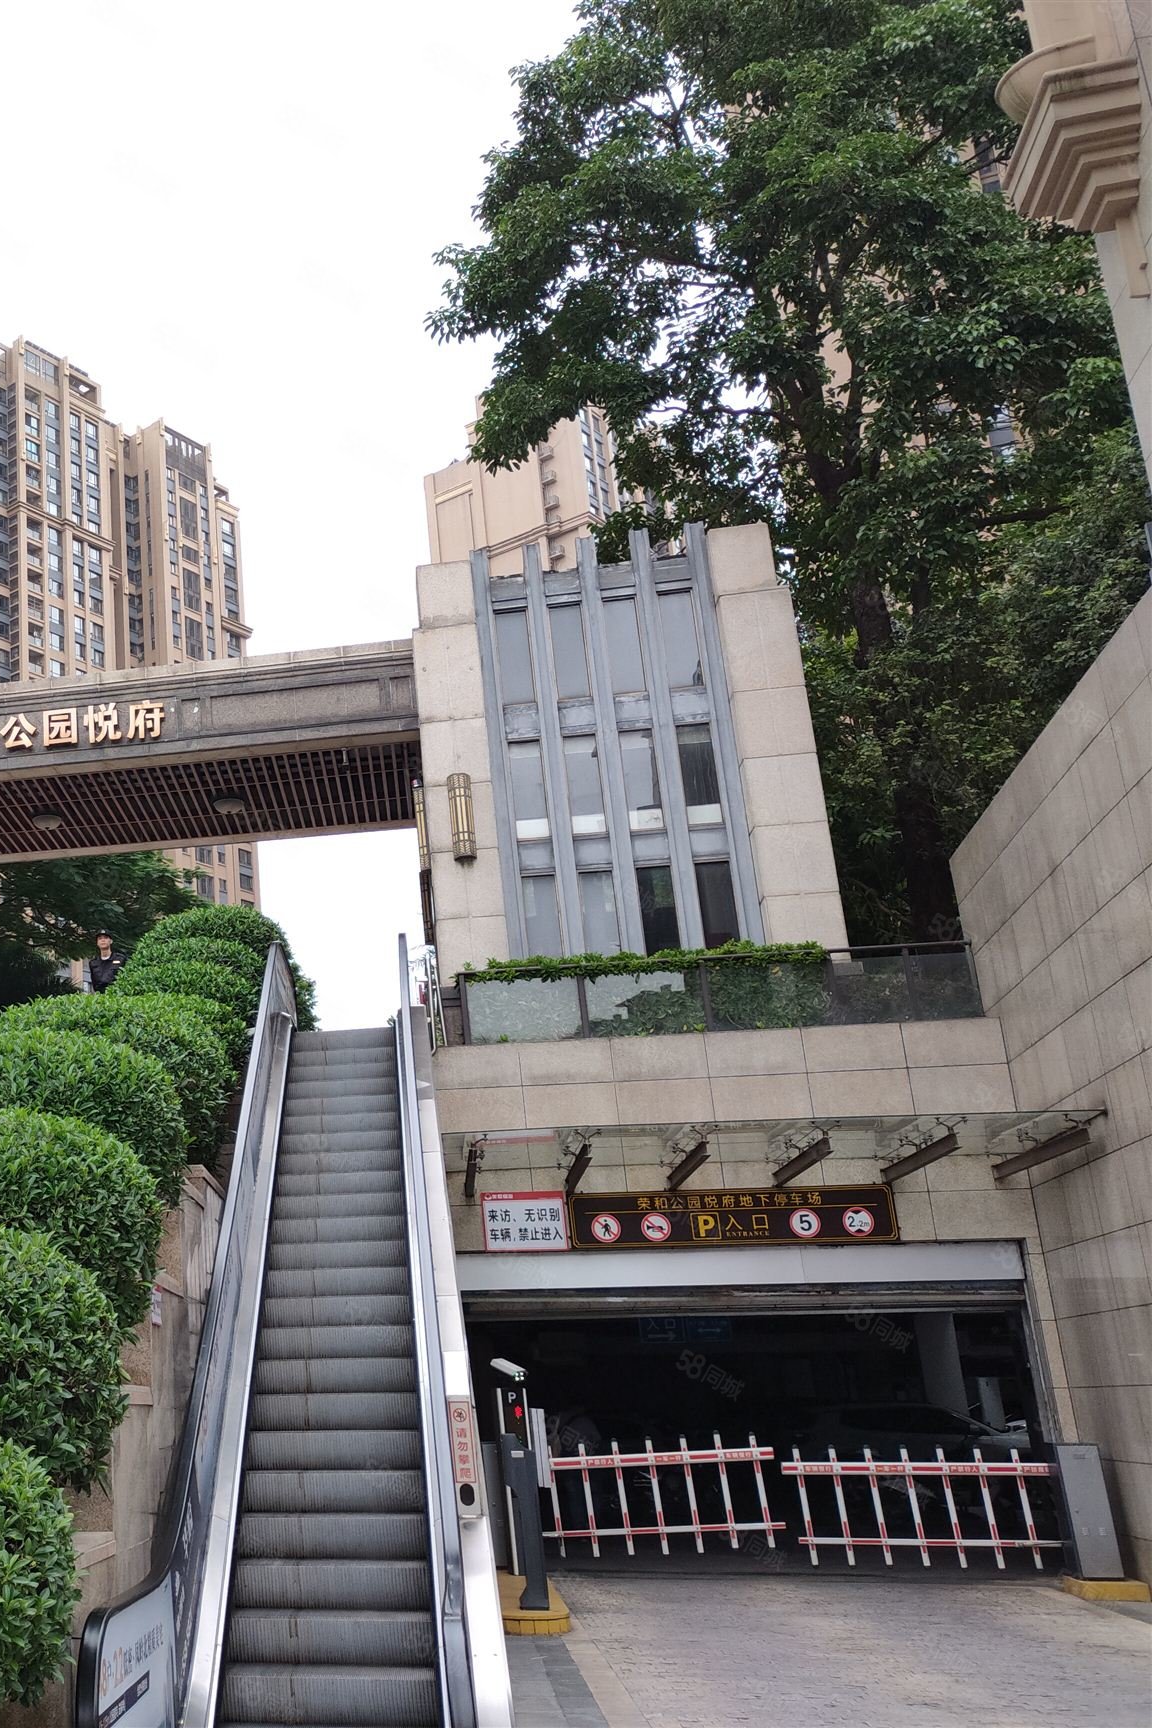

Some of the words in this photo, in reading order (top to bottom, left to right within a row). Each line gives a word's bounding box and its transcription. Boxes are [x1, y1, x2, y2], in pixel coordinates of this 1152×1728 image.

[637, 1191, 823, 1210] 荣和公园悦府地下停车场
[697, 1215, 716, 1238] P
[725, 1214, 769, 1230] 入口
[799, 1214, 813, 1231] 5
[726, 1230, 770, 1238] ENTRANCE
[507, 1392, 517, 1404] P
[455, 1427, 472, 1479] 请勿攀爬
